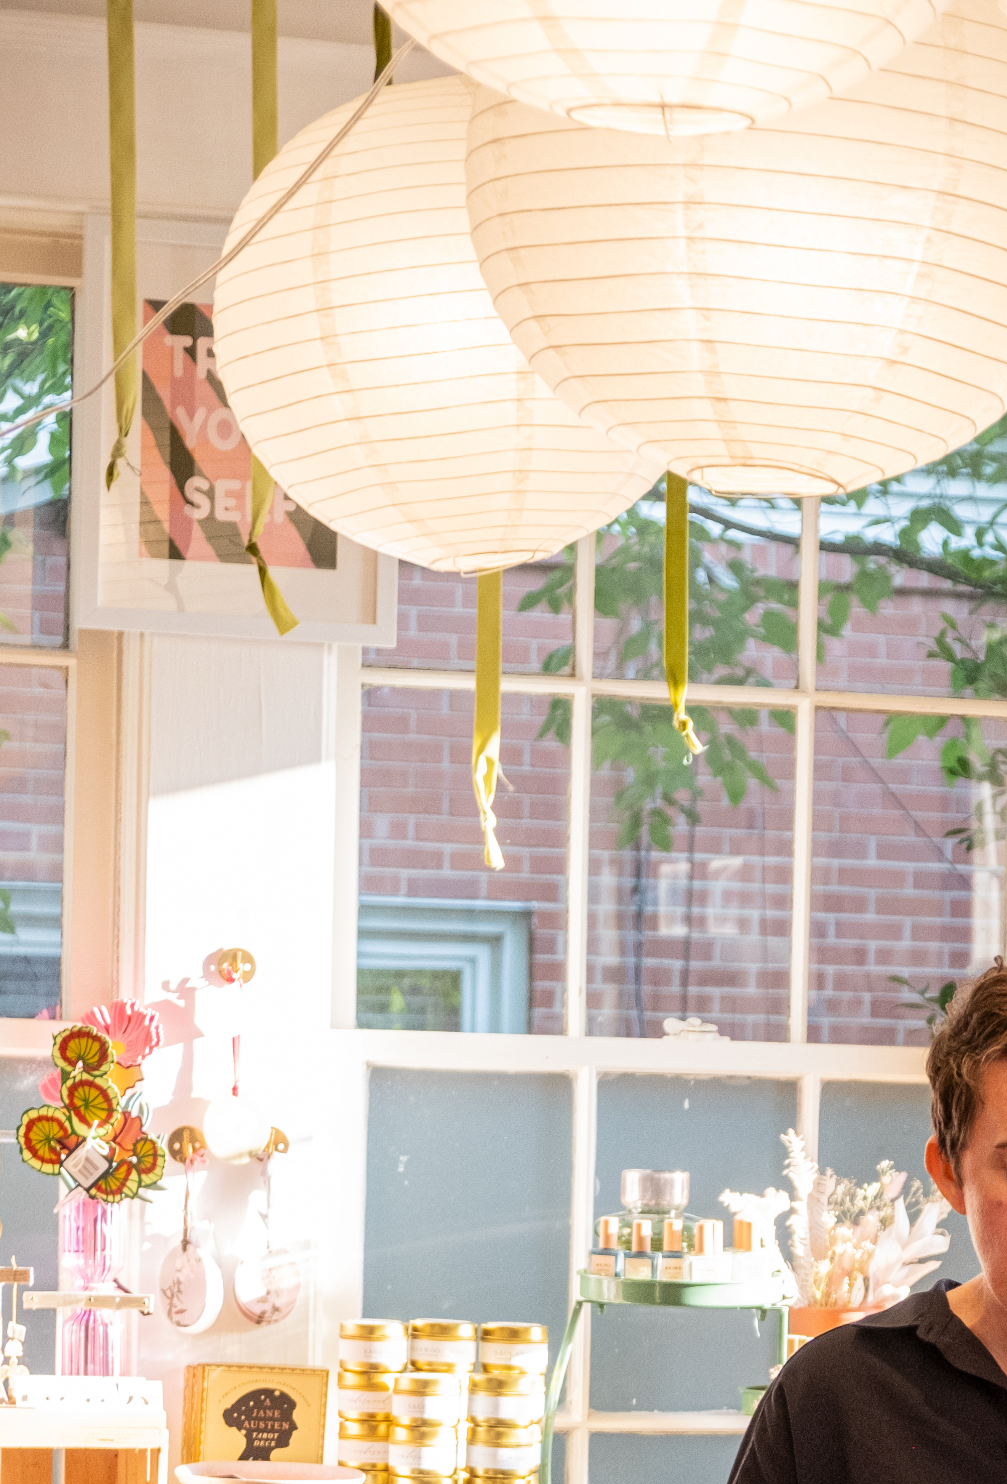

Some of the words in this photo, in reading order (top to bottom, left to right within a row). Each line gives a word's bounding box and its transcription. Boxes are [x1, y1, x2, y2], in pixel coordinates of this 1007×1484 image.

[263, 1397, 271, 1406] A
[251, 1408, 281, 1418] JANE
[242, 1420, 290, 1430] AUSTEN
[252, 1432, 280, 1440] TAROT
[253, 1440, 277, 1448] DECK
